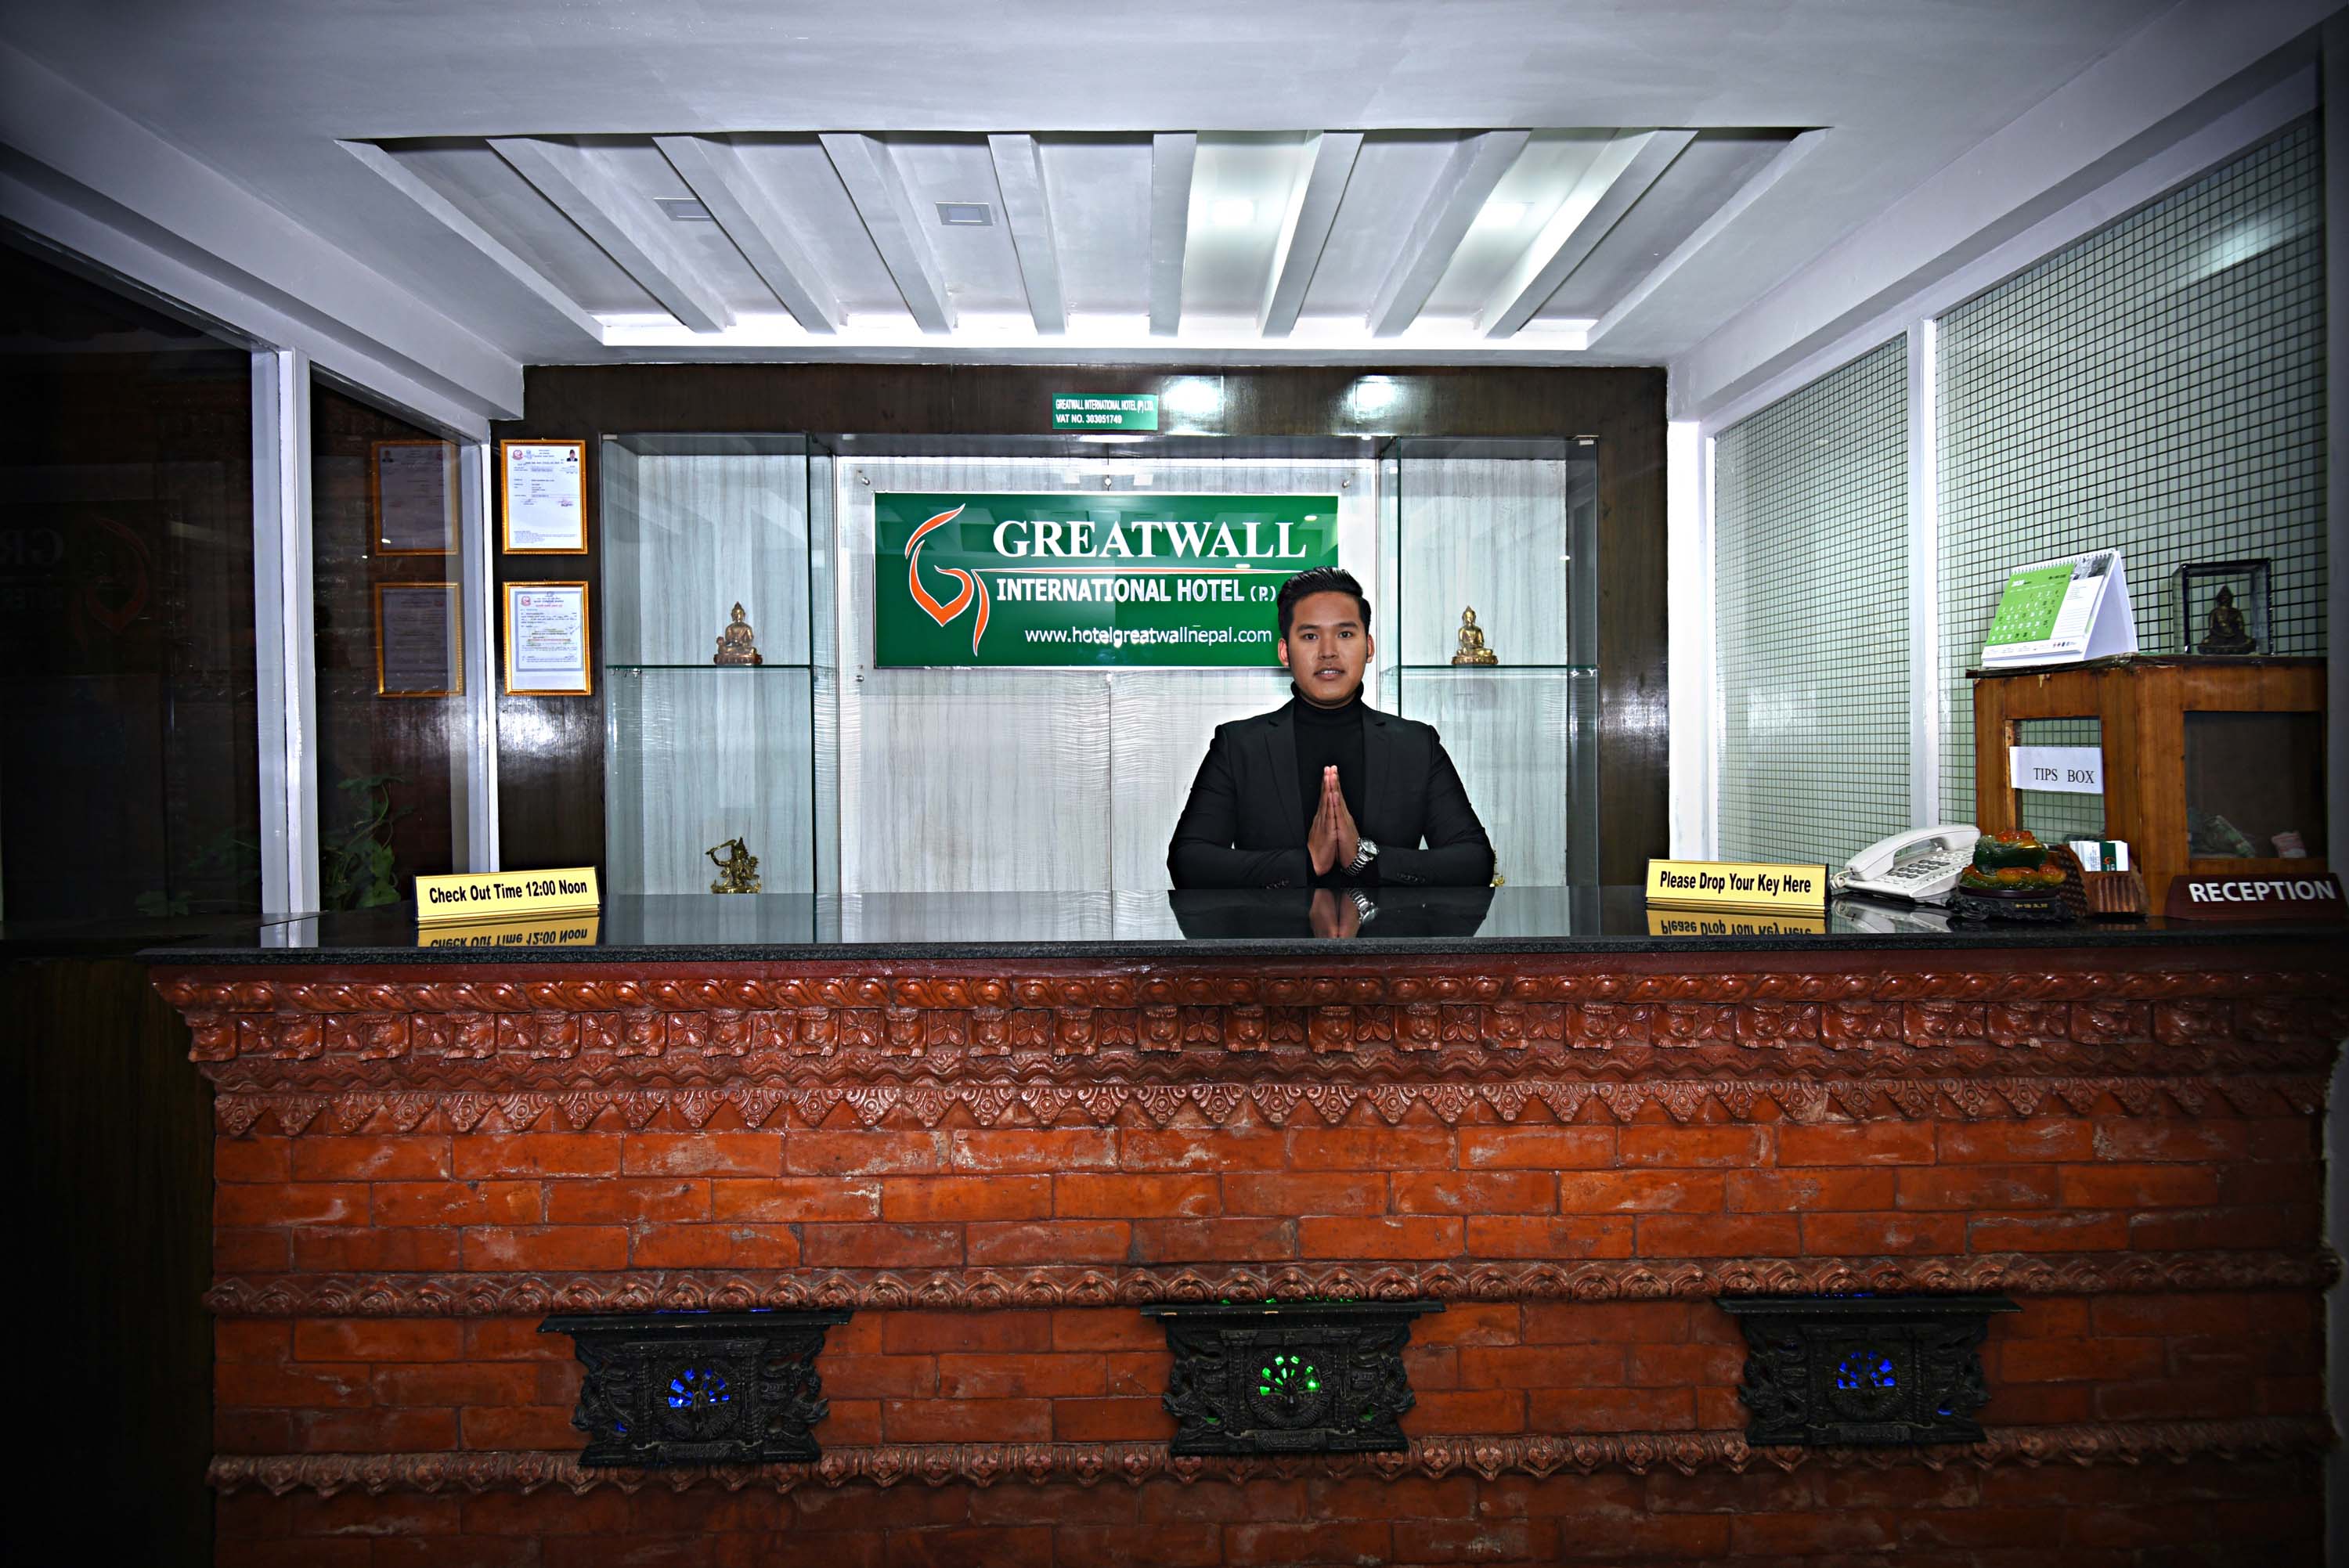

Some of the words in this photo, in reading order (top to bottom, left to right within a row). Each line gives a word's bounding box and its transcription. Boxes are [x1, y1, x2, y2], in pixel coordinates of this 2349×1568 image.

[1055, 398, 1084, 410] GREATWALL
[1084, 399, 1120, 410] INTERNATIONAL
[1121, 400, 1137, 411] HOTEL
[1055, 414, 1070, 423] VAT
[1071, 414, 1084, 424] NO.
[1086, 414, 1123, 424] 303051749
[992, 520, 1307, 558] GREATWALL
[997, 578, 1171, 602] INTERNATIONAL
[1178, 579, 1245, 602] HOTEL
[1024, 626, 1272, 647] www.hotelgreatwallnepal.com
[2033, 767, 2059, 782] TIPS
[2067, 770, 2095, 784] BOX
[429, 886, 467, 903] Check
[470, 884, 491, 901] Out
[493, 882, 522, 899] Time
[525, 881, 556, 897] 12:00
[558, 878, 587, 895] Noon
[1660, 871, 1696, 889] Please
[1699, 872, 1726, 894] Drop
[1729, 873, 1755, 891] Your
[1757, 874, 1780, 896] Key
[1783, 874, 1811, 893] Here
[2188, 880, 2336, 903] RECEPTION
